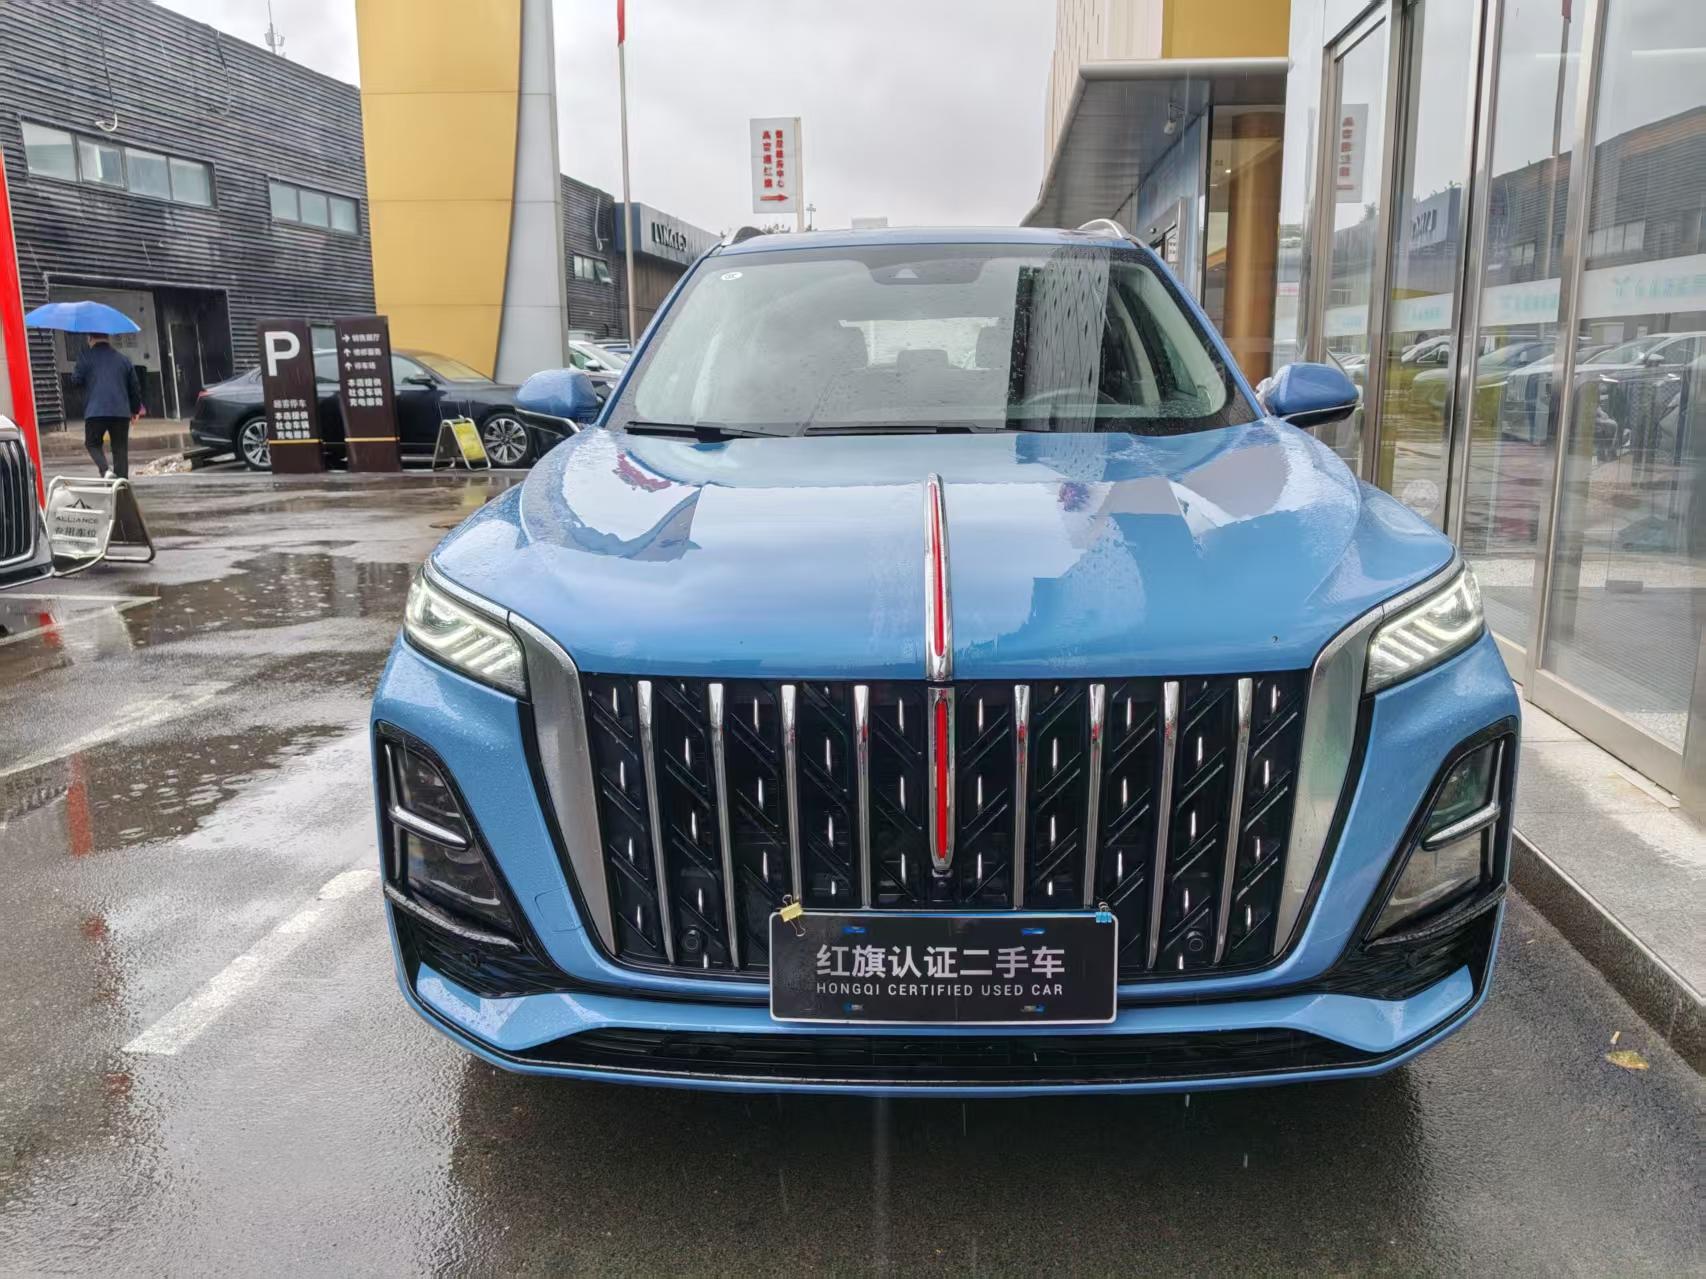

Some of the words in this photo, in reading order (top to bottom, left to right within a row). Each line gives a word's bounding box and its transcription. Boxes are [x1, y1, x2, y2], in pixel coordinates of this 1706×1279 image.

[264, 331, 300, 376] P
[347, 378, 382, 387] 本店提供
[348, 387, 383, 397] 社会车辆
[349, 397, 383, 407] 充电服务
[274, 411, 309, 421] 本店提供
[275, 421, 310, 430] 社会车辆
[277, 430, 310, 439] 充电服务
[816, 944, 1065, 979] 红旗认证二手车
[816, 982, 880, 996] HONGQI
[888, 983, 973, 996] CERTIFIED
[981, 983, 1023, 996] USED
[1031, 983, 1063, 996] CAR
